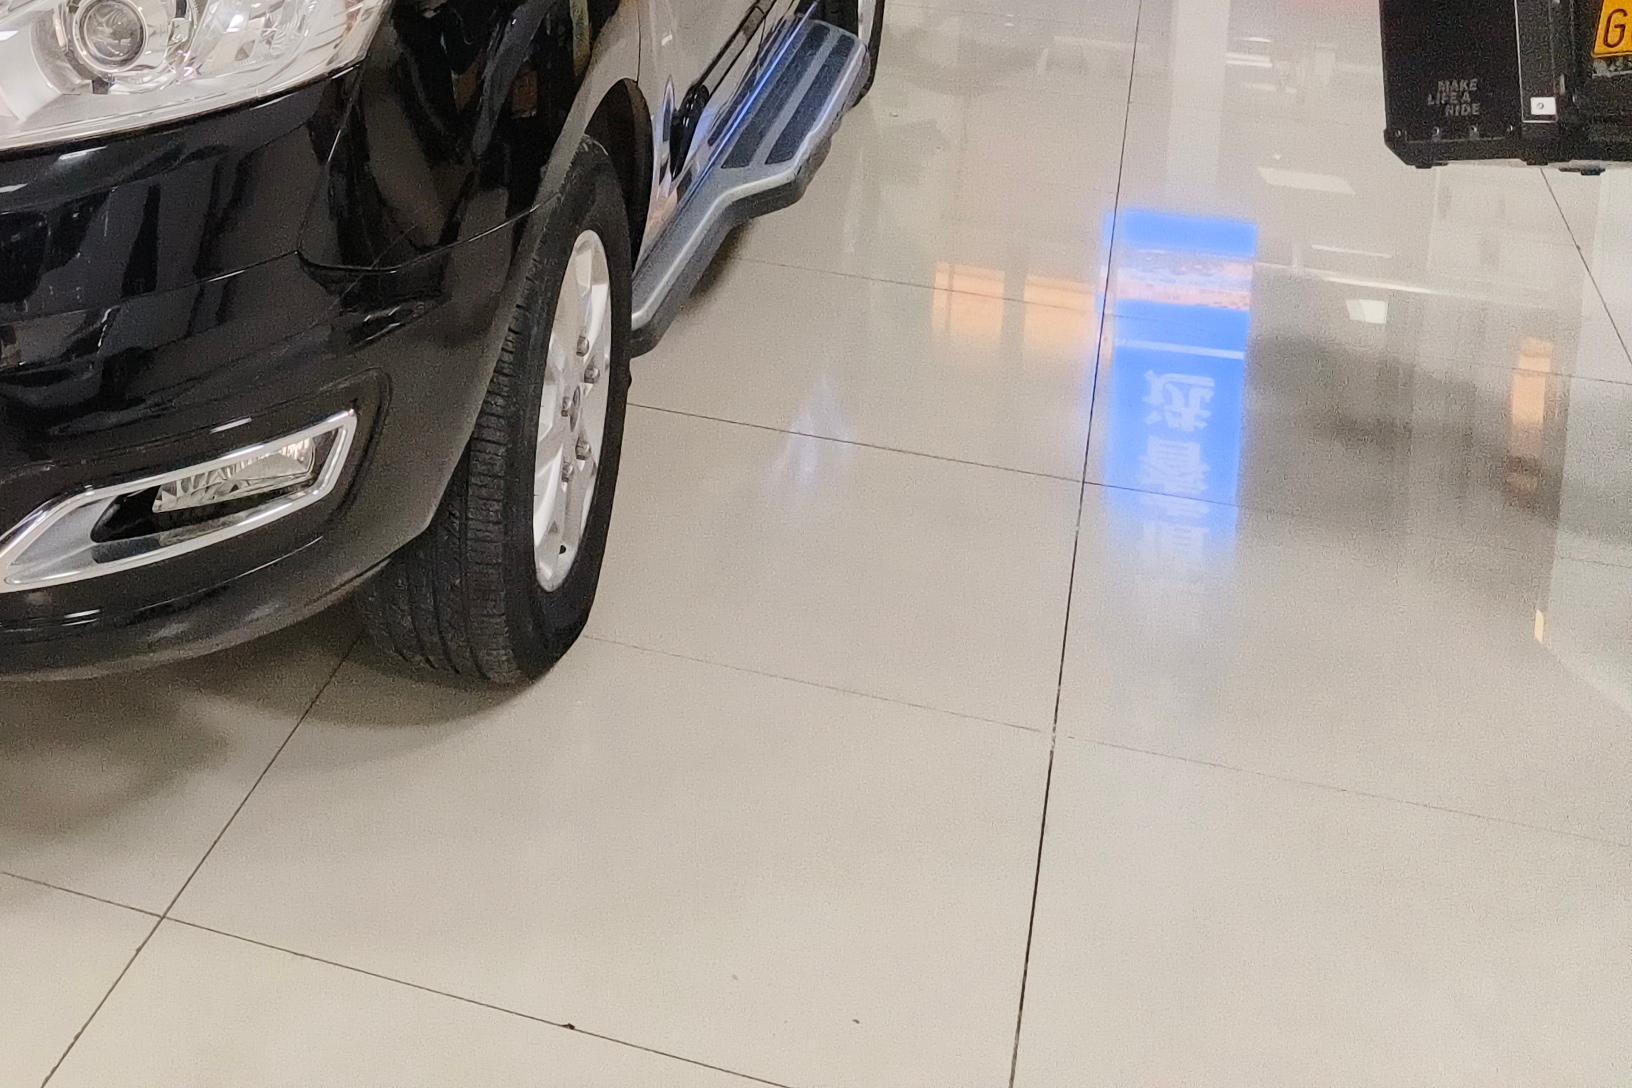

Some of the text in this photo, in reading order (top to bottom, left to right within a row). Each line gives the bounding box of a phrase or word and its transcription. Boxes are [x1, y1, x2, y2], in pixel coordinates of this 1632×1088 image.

[1603, 7, 1632, 49] G
[1438, 78, 1478, 92] MAKE
[1461, 92, 1471, 104] A
